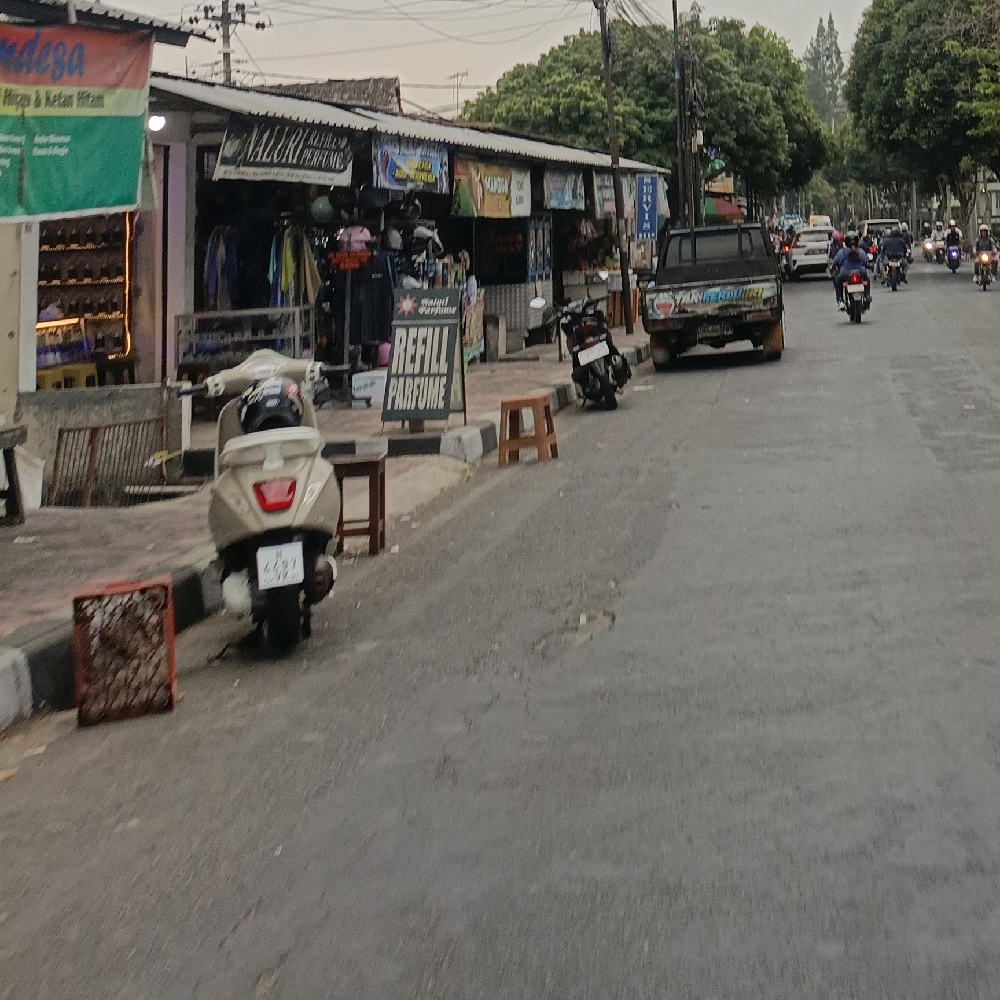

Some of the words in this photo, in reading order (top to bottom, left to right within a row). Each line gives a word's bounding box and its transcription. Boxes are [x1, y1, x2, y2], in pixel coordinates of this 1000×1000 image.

[45, 89, 74, 109] Ketan
[391, 326, 449, 374] REFILL
[387, 376, 447, 411] PARFUME
